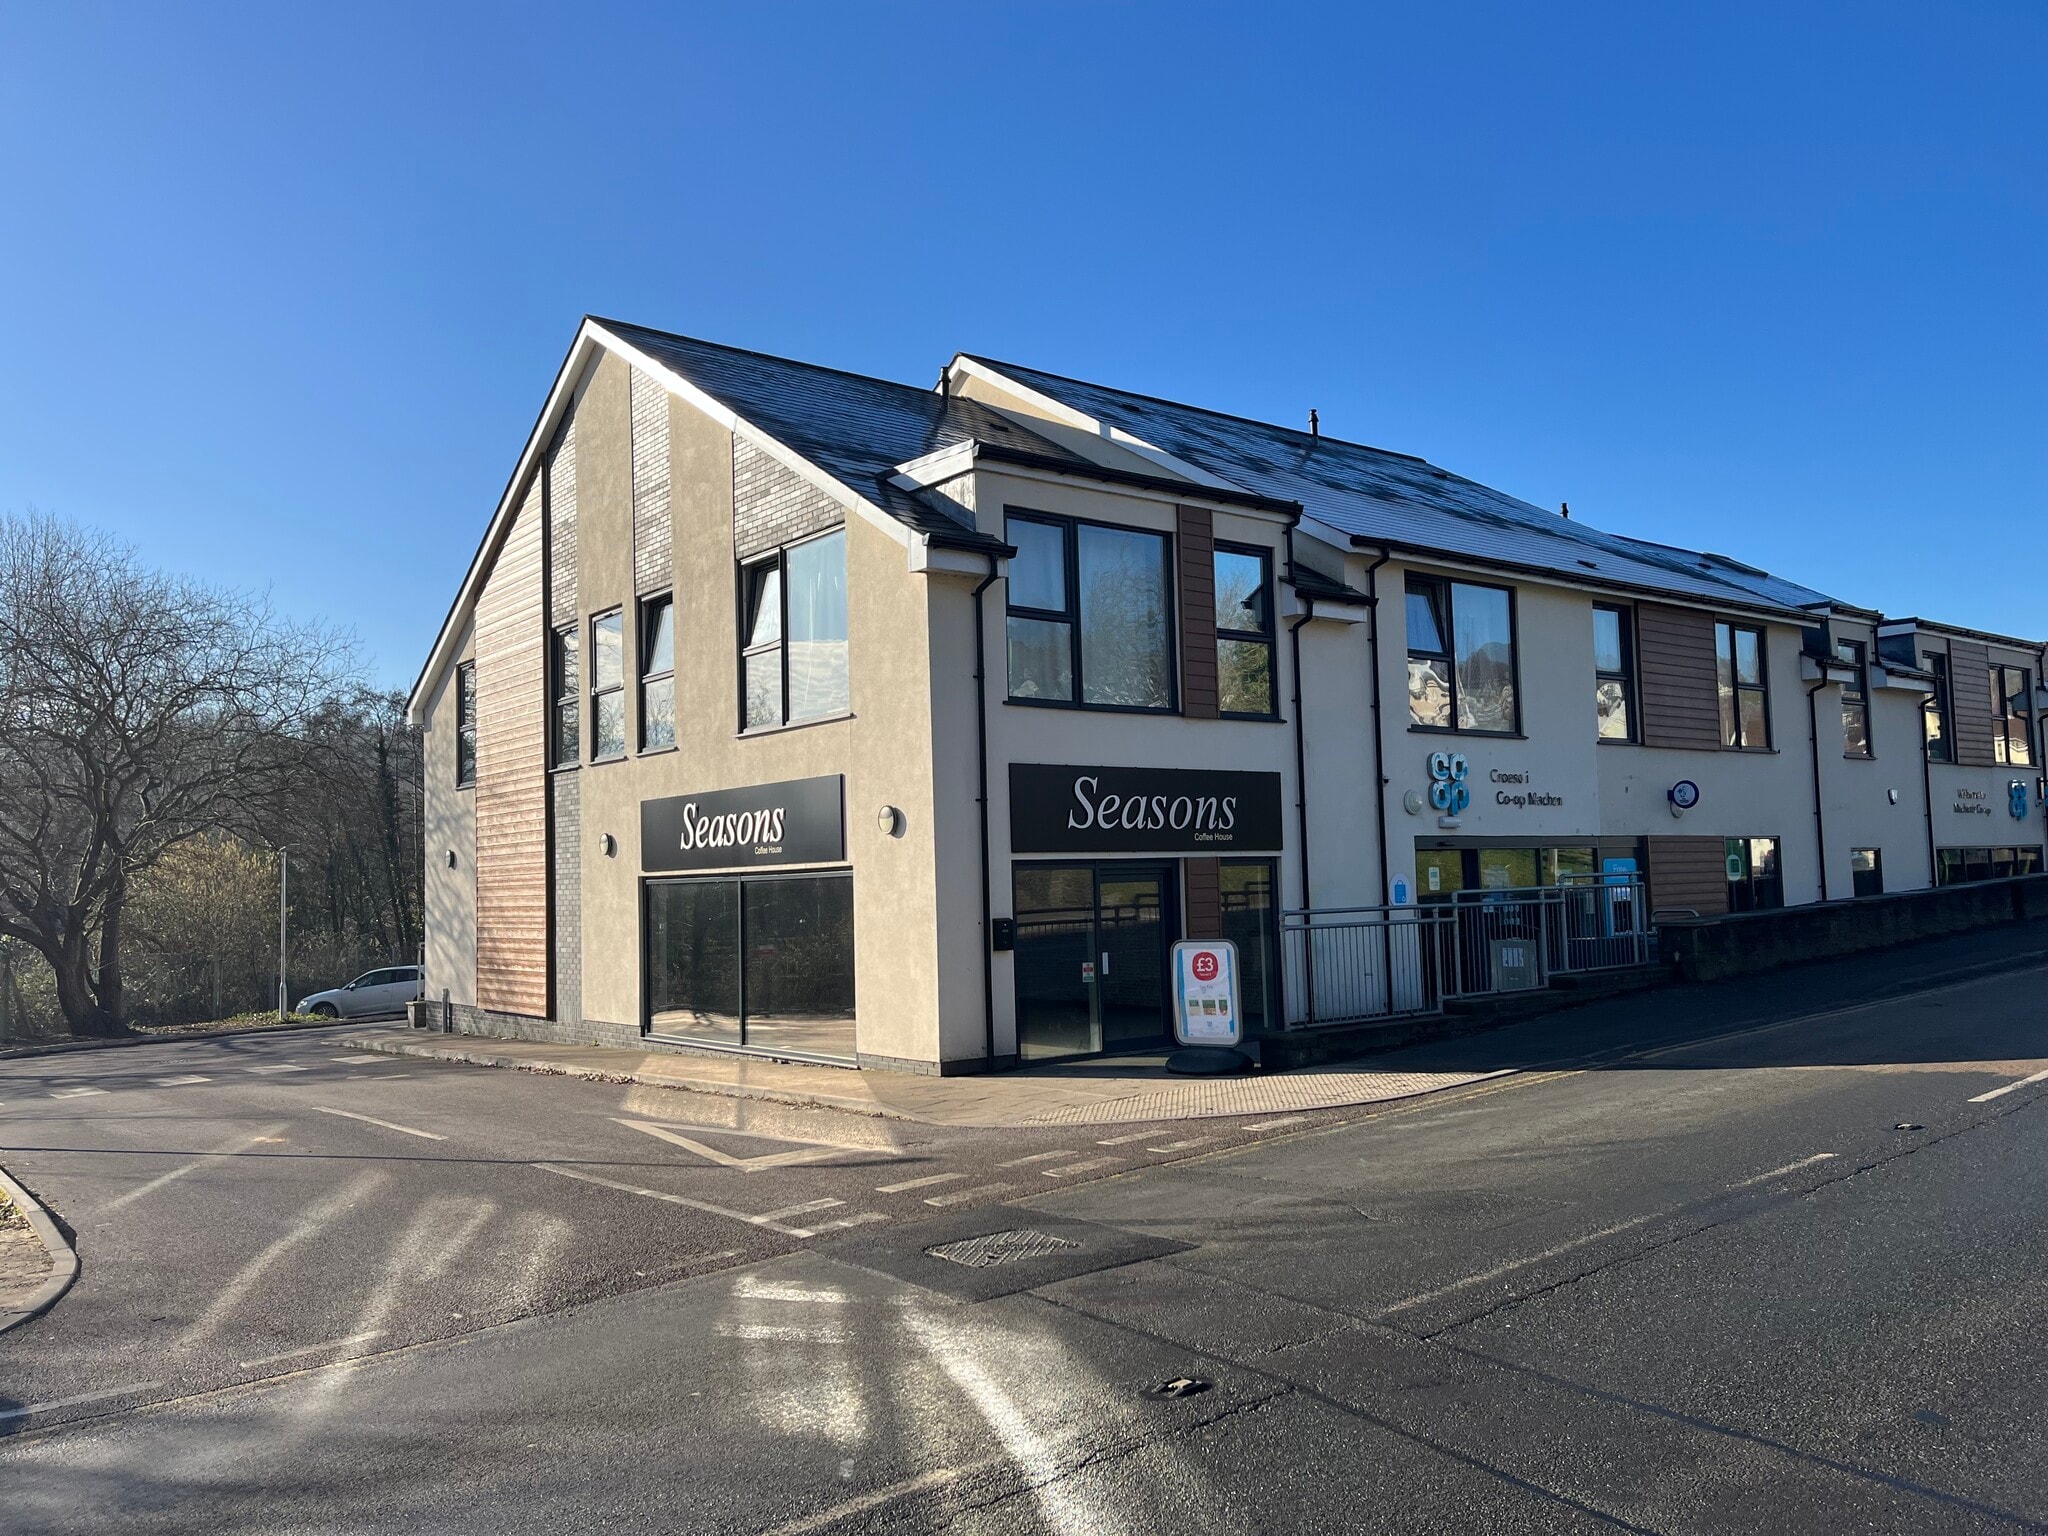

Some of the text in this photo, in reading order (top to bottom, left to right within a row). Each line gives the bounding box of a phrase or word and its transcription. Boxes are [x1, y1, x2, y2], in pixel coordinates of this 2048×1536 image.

[1489, 768, 1530, 784] Croeso i
[1067, 776, 1237, 830] Seasons
[1496, 790, 1526, 809] Co-op
[680, 802, 784, 850] Seasons
[1194, 832, 1233, 841] Coffee House
[754, 845, 782, 855] Coffee House
[1196, 957, 1214, 972] £3
